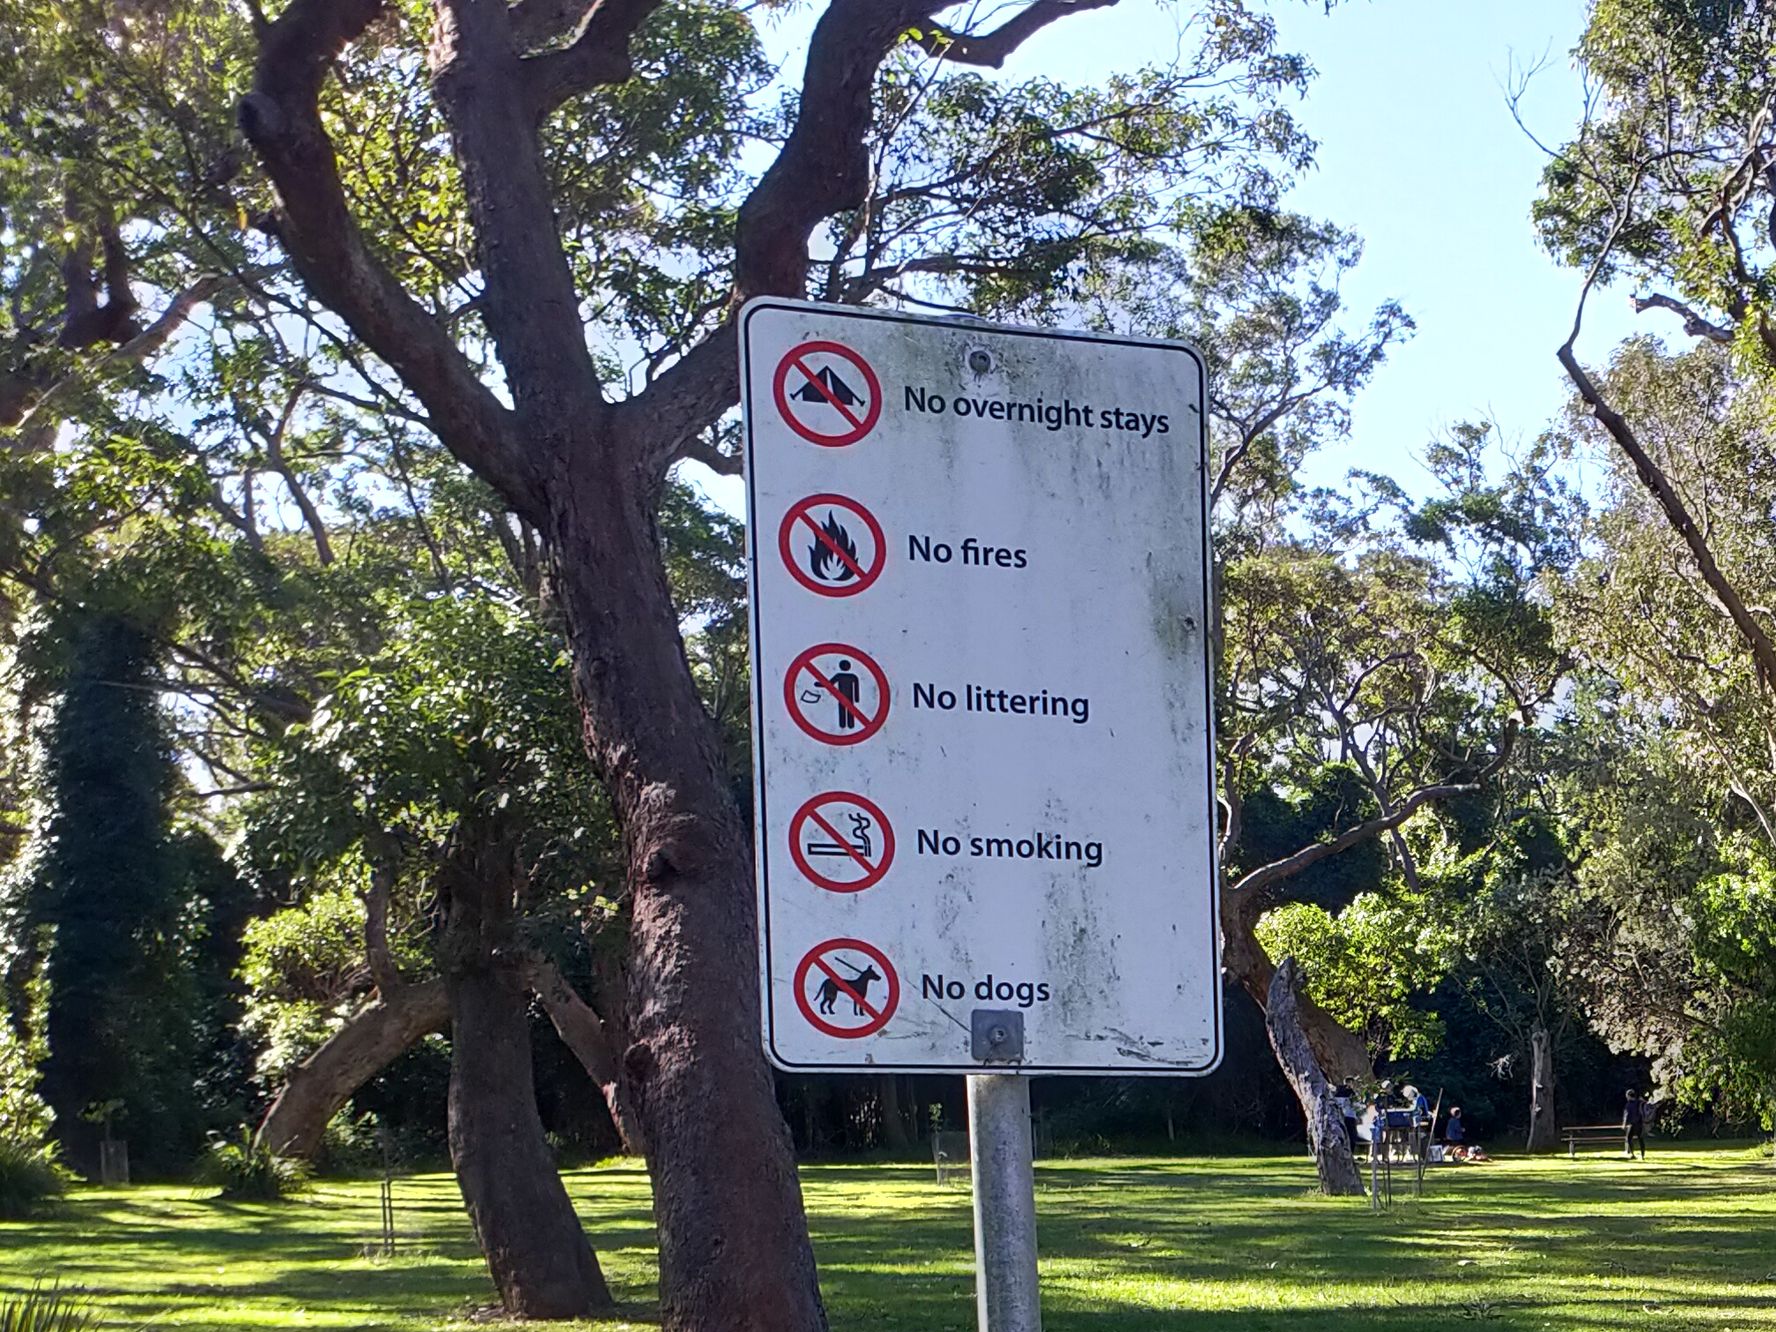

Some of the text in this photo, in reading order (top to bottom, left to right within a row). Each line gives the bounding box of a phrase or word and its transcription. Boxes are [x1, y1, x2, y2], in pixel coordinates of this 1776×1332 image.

[905, 386, 1170, 438] No overnight stays
[909, 536, 1027, 568] No fires
[913, 683, 1090, 723] No littering
[917, 830, 1103, 867] No smoking
[922, 975, 1050, 1007] No dogs
